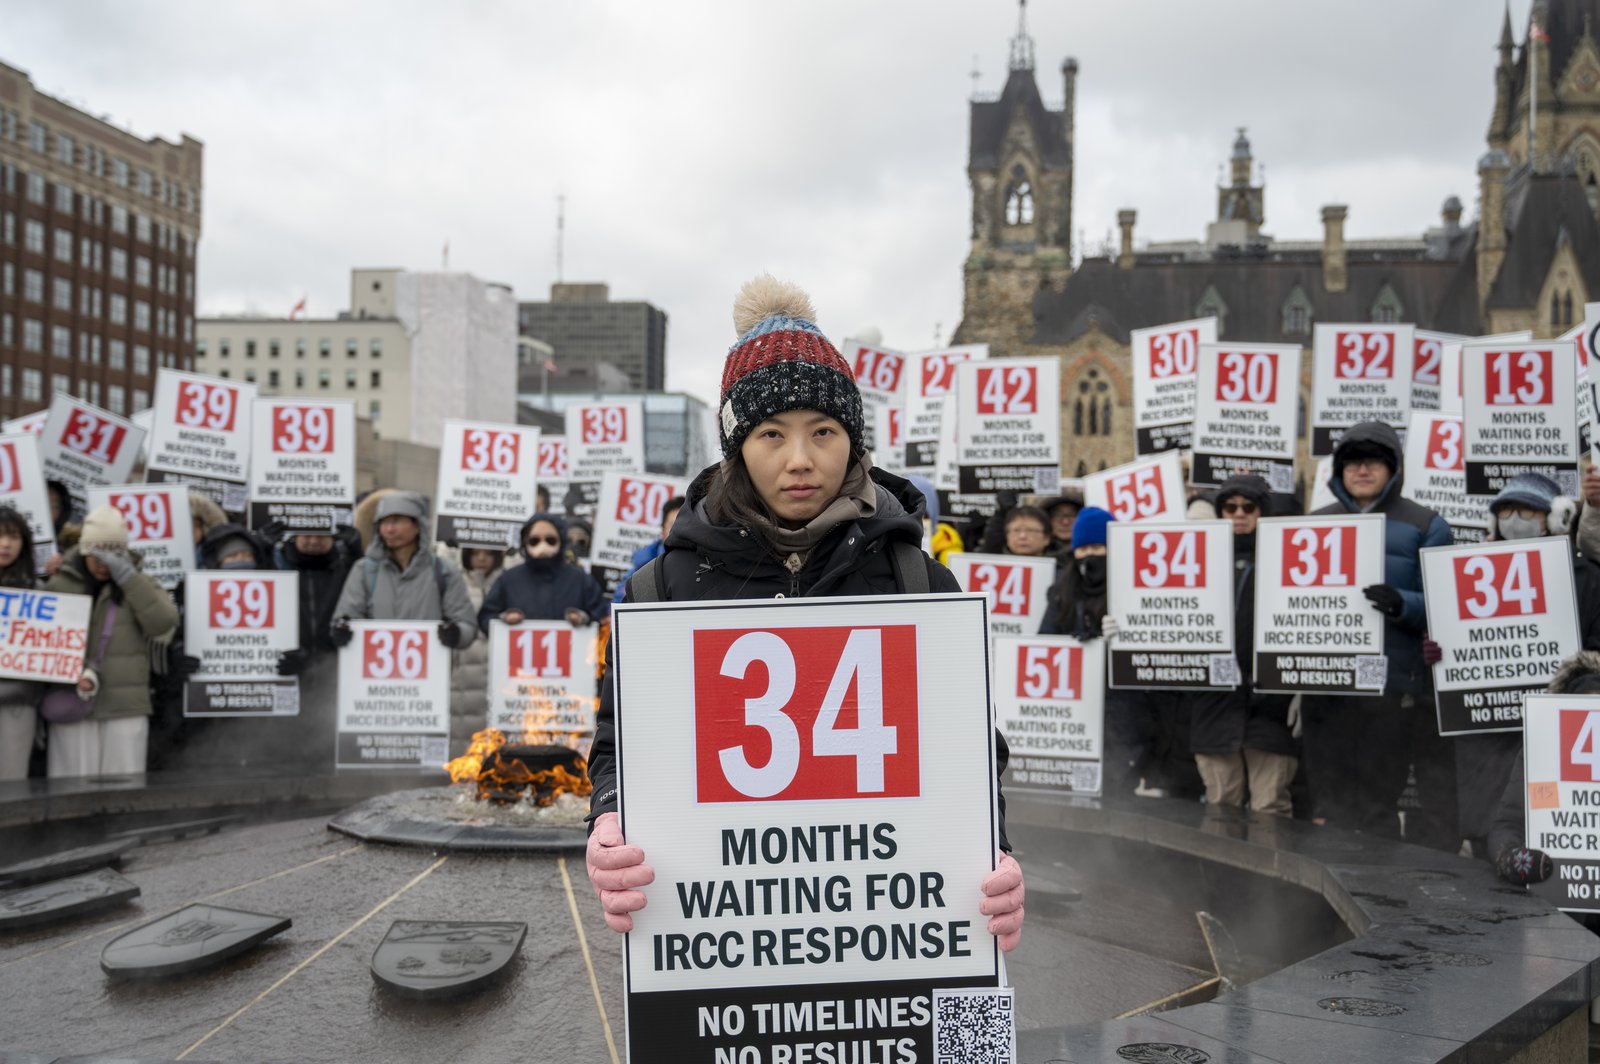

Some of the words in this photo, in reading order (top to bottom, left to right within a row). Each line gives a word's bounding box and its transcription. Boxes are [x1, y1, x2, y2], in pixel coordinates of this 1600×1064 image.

[1153, 331, 1195, 377] 30
[1340, 334, 1389, 378] 32
[857, 350, 897, 391] 16
[925, 354, 968, 396] 27
[1221, 354, 1272, 402] 30
[1493, 352, 1544, 404] 13
[982, 368, 1032, 413] 42
[1339, 385, 1385, 394] MONTHS
[1412, 389, 1438, 400] MON
[182, 383, 231, 430] 39
[1326, 398, 1373, 408] WAITING
[1375, 398, 1396, 408] FOR
[1221, 409, 1269, 420] MONTHS
[1492, 413, 1545, 423] MONTHS
[279, 408, 328, 451] 39
[585, 408, 624, 443] 39
[983, 421, 1030, 431] MONTHS
[1207, 422, 1256, 434] WAITING
[1259, 424, 1281, 436] FOR
[68, 414, 116, 459] 31
[971, 435, 1019, 445] WAITING
[1022, 434, 1044, 445] FOR
[1479, 428, 1532, 439] WAITING
[1536, 428, 1560, 439] FOR
[1200, 437, 1224, 448] IRCC
[1227, 438, 1288, 451] RESPONSE
[1472, 444, 1498, 455] IRCC
[1502, 444, 1569, 455] RESPONSE
[467, 431, 515, 473] 36
[992, 448, 1051, 459] RESPONSE
[278, 459, 326, 469] MONTHS
[541, 444, 568, 476] 28
[265, 473, 314, 482] WAITING
[317, 473, 339, 483] FOR
[1484, 465, 1501, 476] NO
[1429, 476, 1463, 488] MONT
[285, 486, 346, 497] RESPONSE
[1114, 468, 1160, 521] 55
[1414, 490, 1465, 503] WAITING
[621, 481, 668, 527] 30
[116, 496, 167, 542] 39
[1139, 532, 1201, 588] 34
[1289, 527, 1348, 586] 31
[975, 565, 1025, 615] 34
[1463, 552, 1537, 618] 34
[0, 591, 57, 620] THE
[215, 581, 269, 628] 39
[1142, 598, 1198, 609] MONTHS
[1288, 596, 1347, 608] MONTHS
[1127, 614, 1184, 626] WAITING
[1188, 614, 1214, 626] FOR
[1273, 614, 1332, 626] WAITING
[1336, 613, 1363, 626] FOR
[991, 623, 1022, 634] NTHS
[1469, 624, 1539, 642] MONTHS
[215, 636, 266, 646] MONTHS
[1119, 631, 1148, 643] IRCC
[1151, 631, 1223, 643] RESPONSE
[1264, 632, 1294, 644] IRCC
[1298, 631, 1371, 644] RESPONSE
[201, 650, 253, 660] WAITING
[368, 631, 422, 679] 36
[516, 631, 563, 677] 11
[1453, 645, 1522, 662] WAITING
[1528, 641, 1560, 657] FOR
[0, 649, 83, 678] OGETHER
[1132, 655, 1150, 667] NO
[1151, 655, 1209, 667] TIMELINES
[1277, 656, 1296, 669] NO
[1297, 656, 1356, 669] TIMELINES
[1023, 647, 1075, 698] 51
[1137, 669, 1154, 680] NO
[1156, 669, 1205, 680] RESULTS
[1282, 671, 1299, 682] NO
[1301, 670, 1352, 683] RESULTS
[1445, 666, 1481, 682] IRCC
[1485, 660, 1560, 679] RESPONS
[368, 687, 419, 697] MONTHS
[353, 701, 406, 711] WAITING
[409, 701, 433, 712] FOR
[1464, 693, 1483, 708] NO
[718, 629, 897, 798] 34
[1021, 706, 1073, 718] MONTHS
[1471, 708, 1492, 722] NO
[375, 716, 440, 726] RESPONSE
[1007, 722, 1059, 734] WAITING
[1062, 723, 1086, 735] FOR
[1028, 738, 1093, 751] RESPONSE
[1552, 811, 1600, 828] WAIT
[722, 823, 898, 866] MONTHS
[1540, 833, 1582, 850] IRCC
[1560, 865, 1582, 880] NO
[676, 875, 852, 919] WAITING
[865, 872, 946, 912] FOR
[1568, 884, 1590, 899] NO
[653, 930, 744, 971] IRCC
[753, 921, 972, 966] RESPONSE
[698, 1005, 744, 1036] NO
[752, 996, 931, 1034] TIMELINES
[714, 1045, 761, 1064] NO
[771, 1038, 917, 1064] RESULTS
